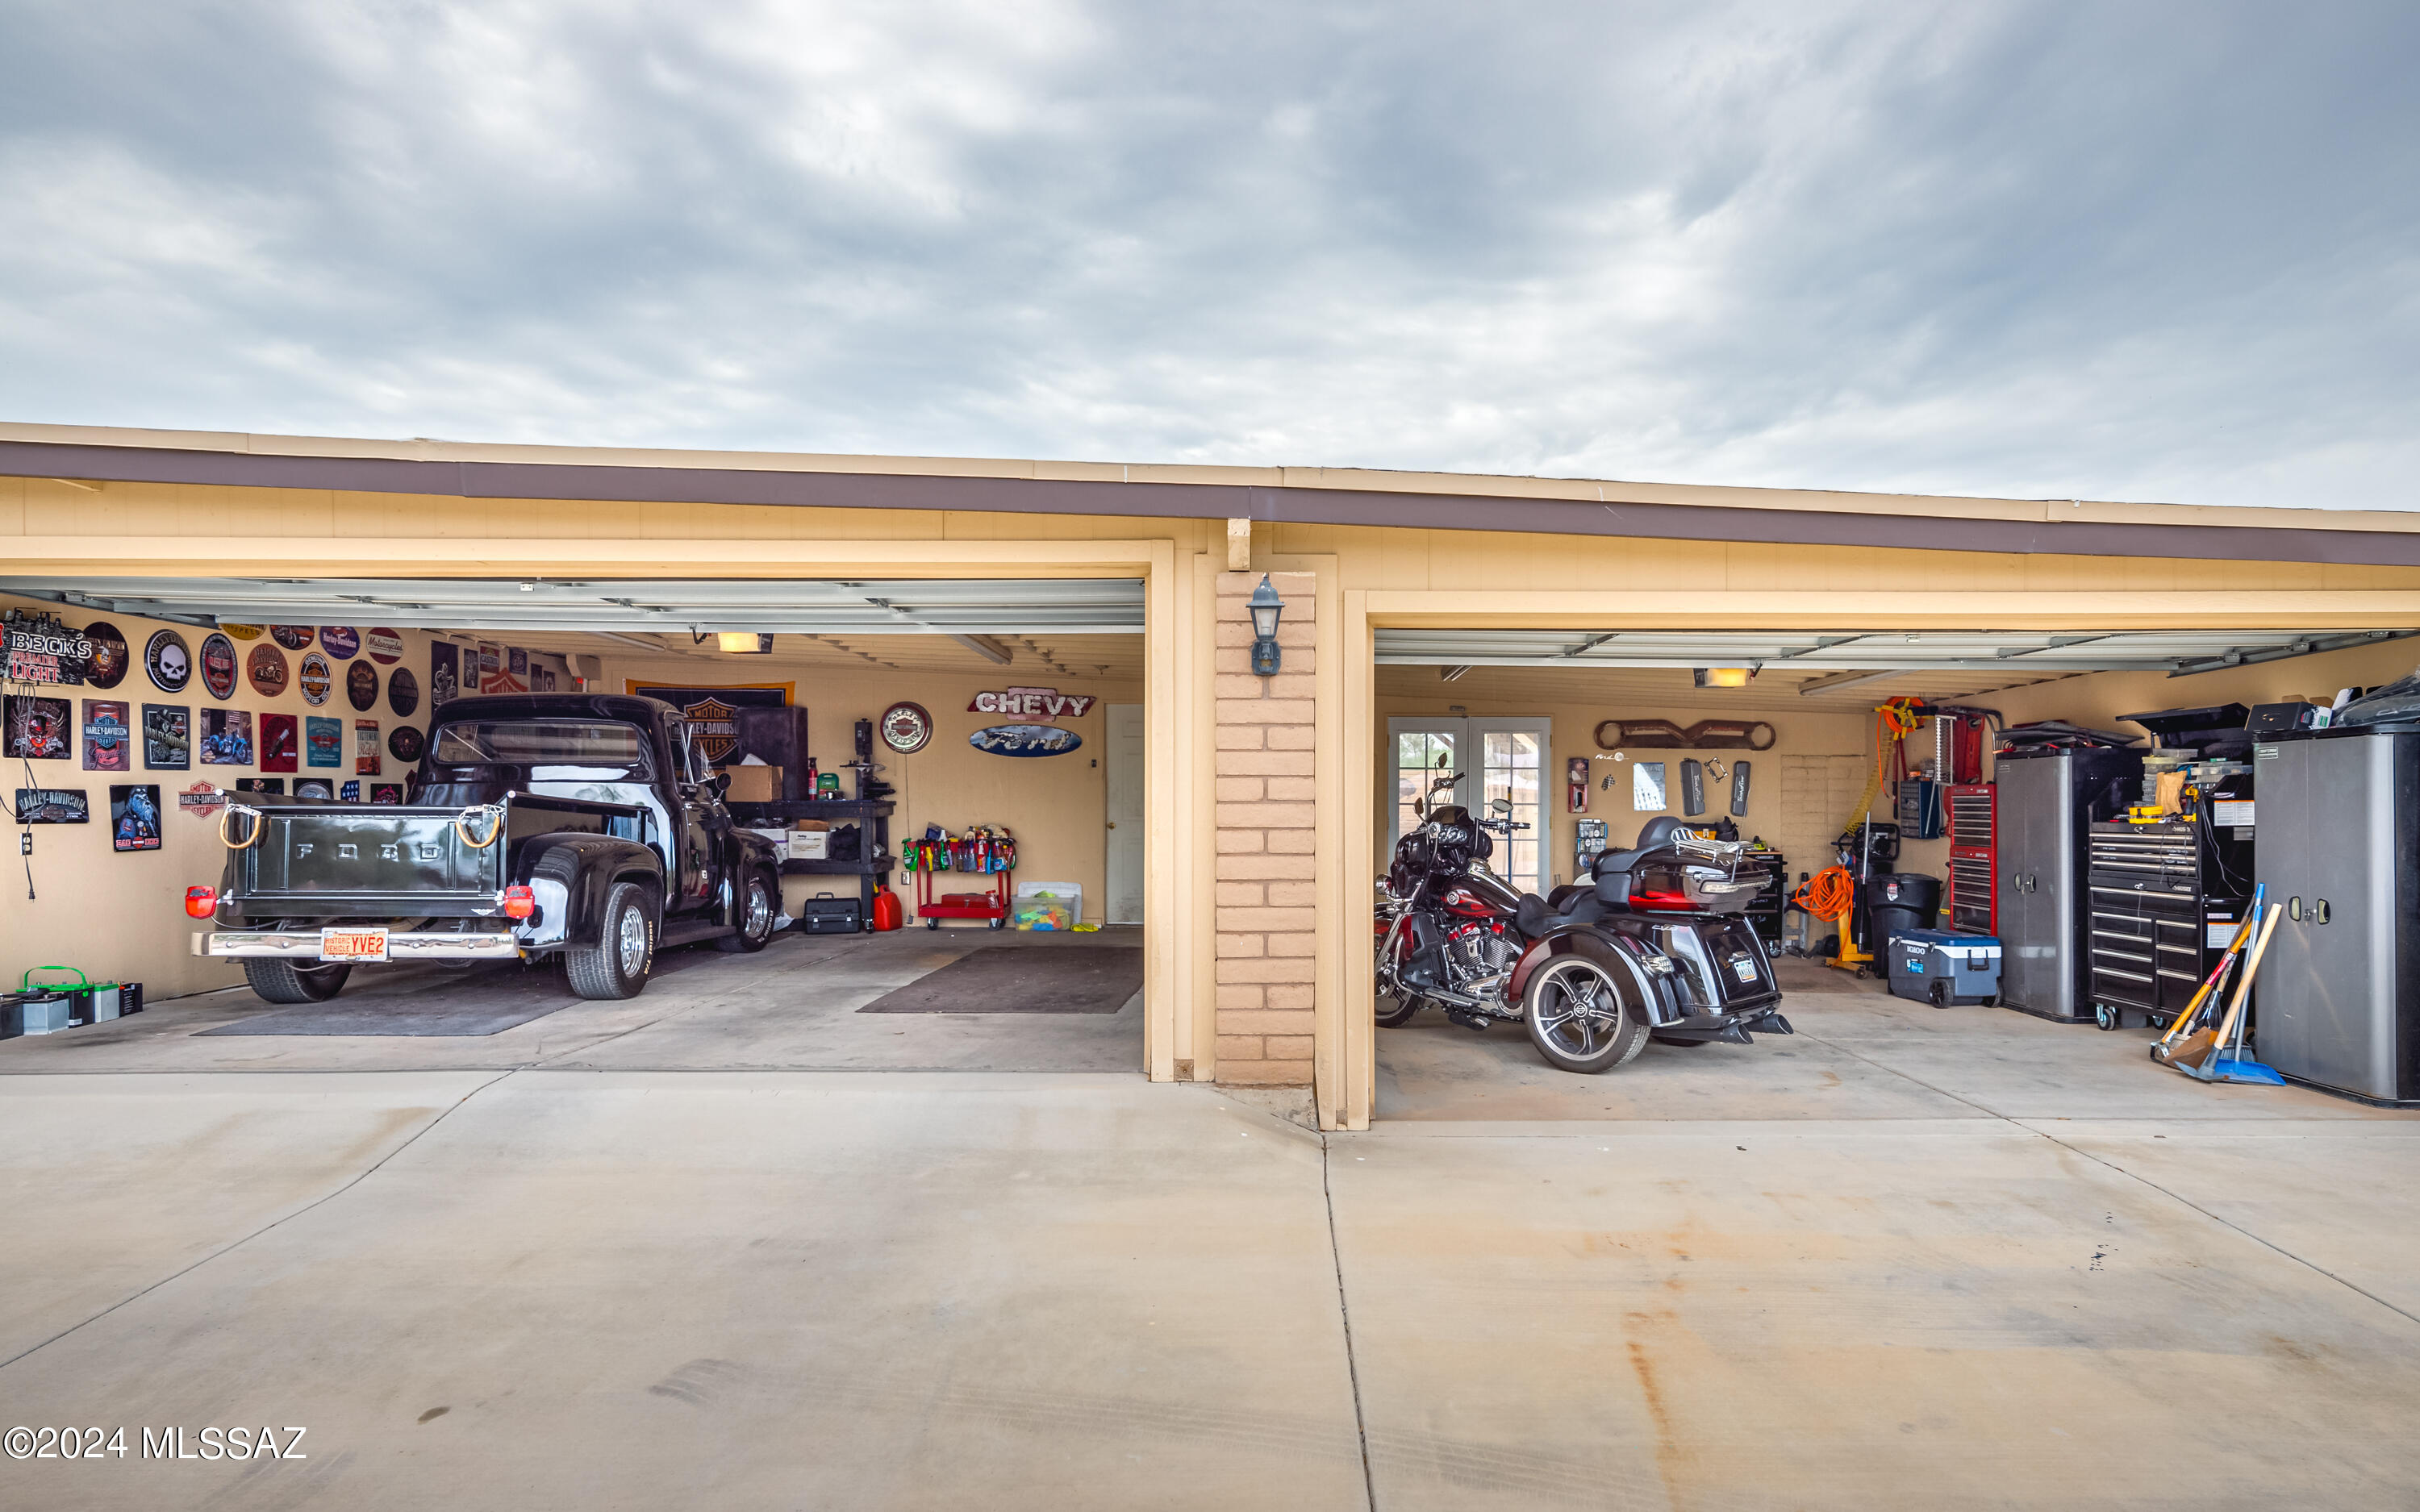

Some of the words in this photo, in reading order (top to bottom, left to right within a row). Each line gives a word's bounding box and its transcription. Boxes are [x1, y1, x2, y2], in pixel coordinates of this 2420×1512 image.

[10, 631, 93, 660] BECK'S
[323, 632, 357, 648] Harley-Davidson
[368, 636, 403, 652] Motorcycles
[12, 652, 60, 667] PREMIER
[305, 654, 325, 665] GENUINE
[12, 662, 60, 683] LIGHT
[302, 687, 320, 704] MOTOR
[695, 705, 728, 718] MOTOR
[975, 692, 1089, 717] CHEVY
[85, 726, 127, 735] HARLEY-DAVIDSON
[145, 725, 190, 751] HARLEY-DAVIDSON
[978, 731, 1072, 751] Ford
[194, 783, 211, 792] MOTOR
[18, 791, 86, 811] HARLEY-DAVIDSON
[181, 794, 224, 804] HARLEY-DAVIDSON
[115, 839, 131, 848] BAD
[296, 843, 441, 862] FORD
[352, 936, 384, 953] YVE2
[1907, 945, 1926, 956] IGLOO
[644, 960, 652, 974] T/A
